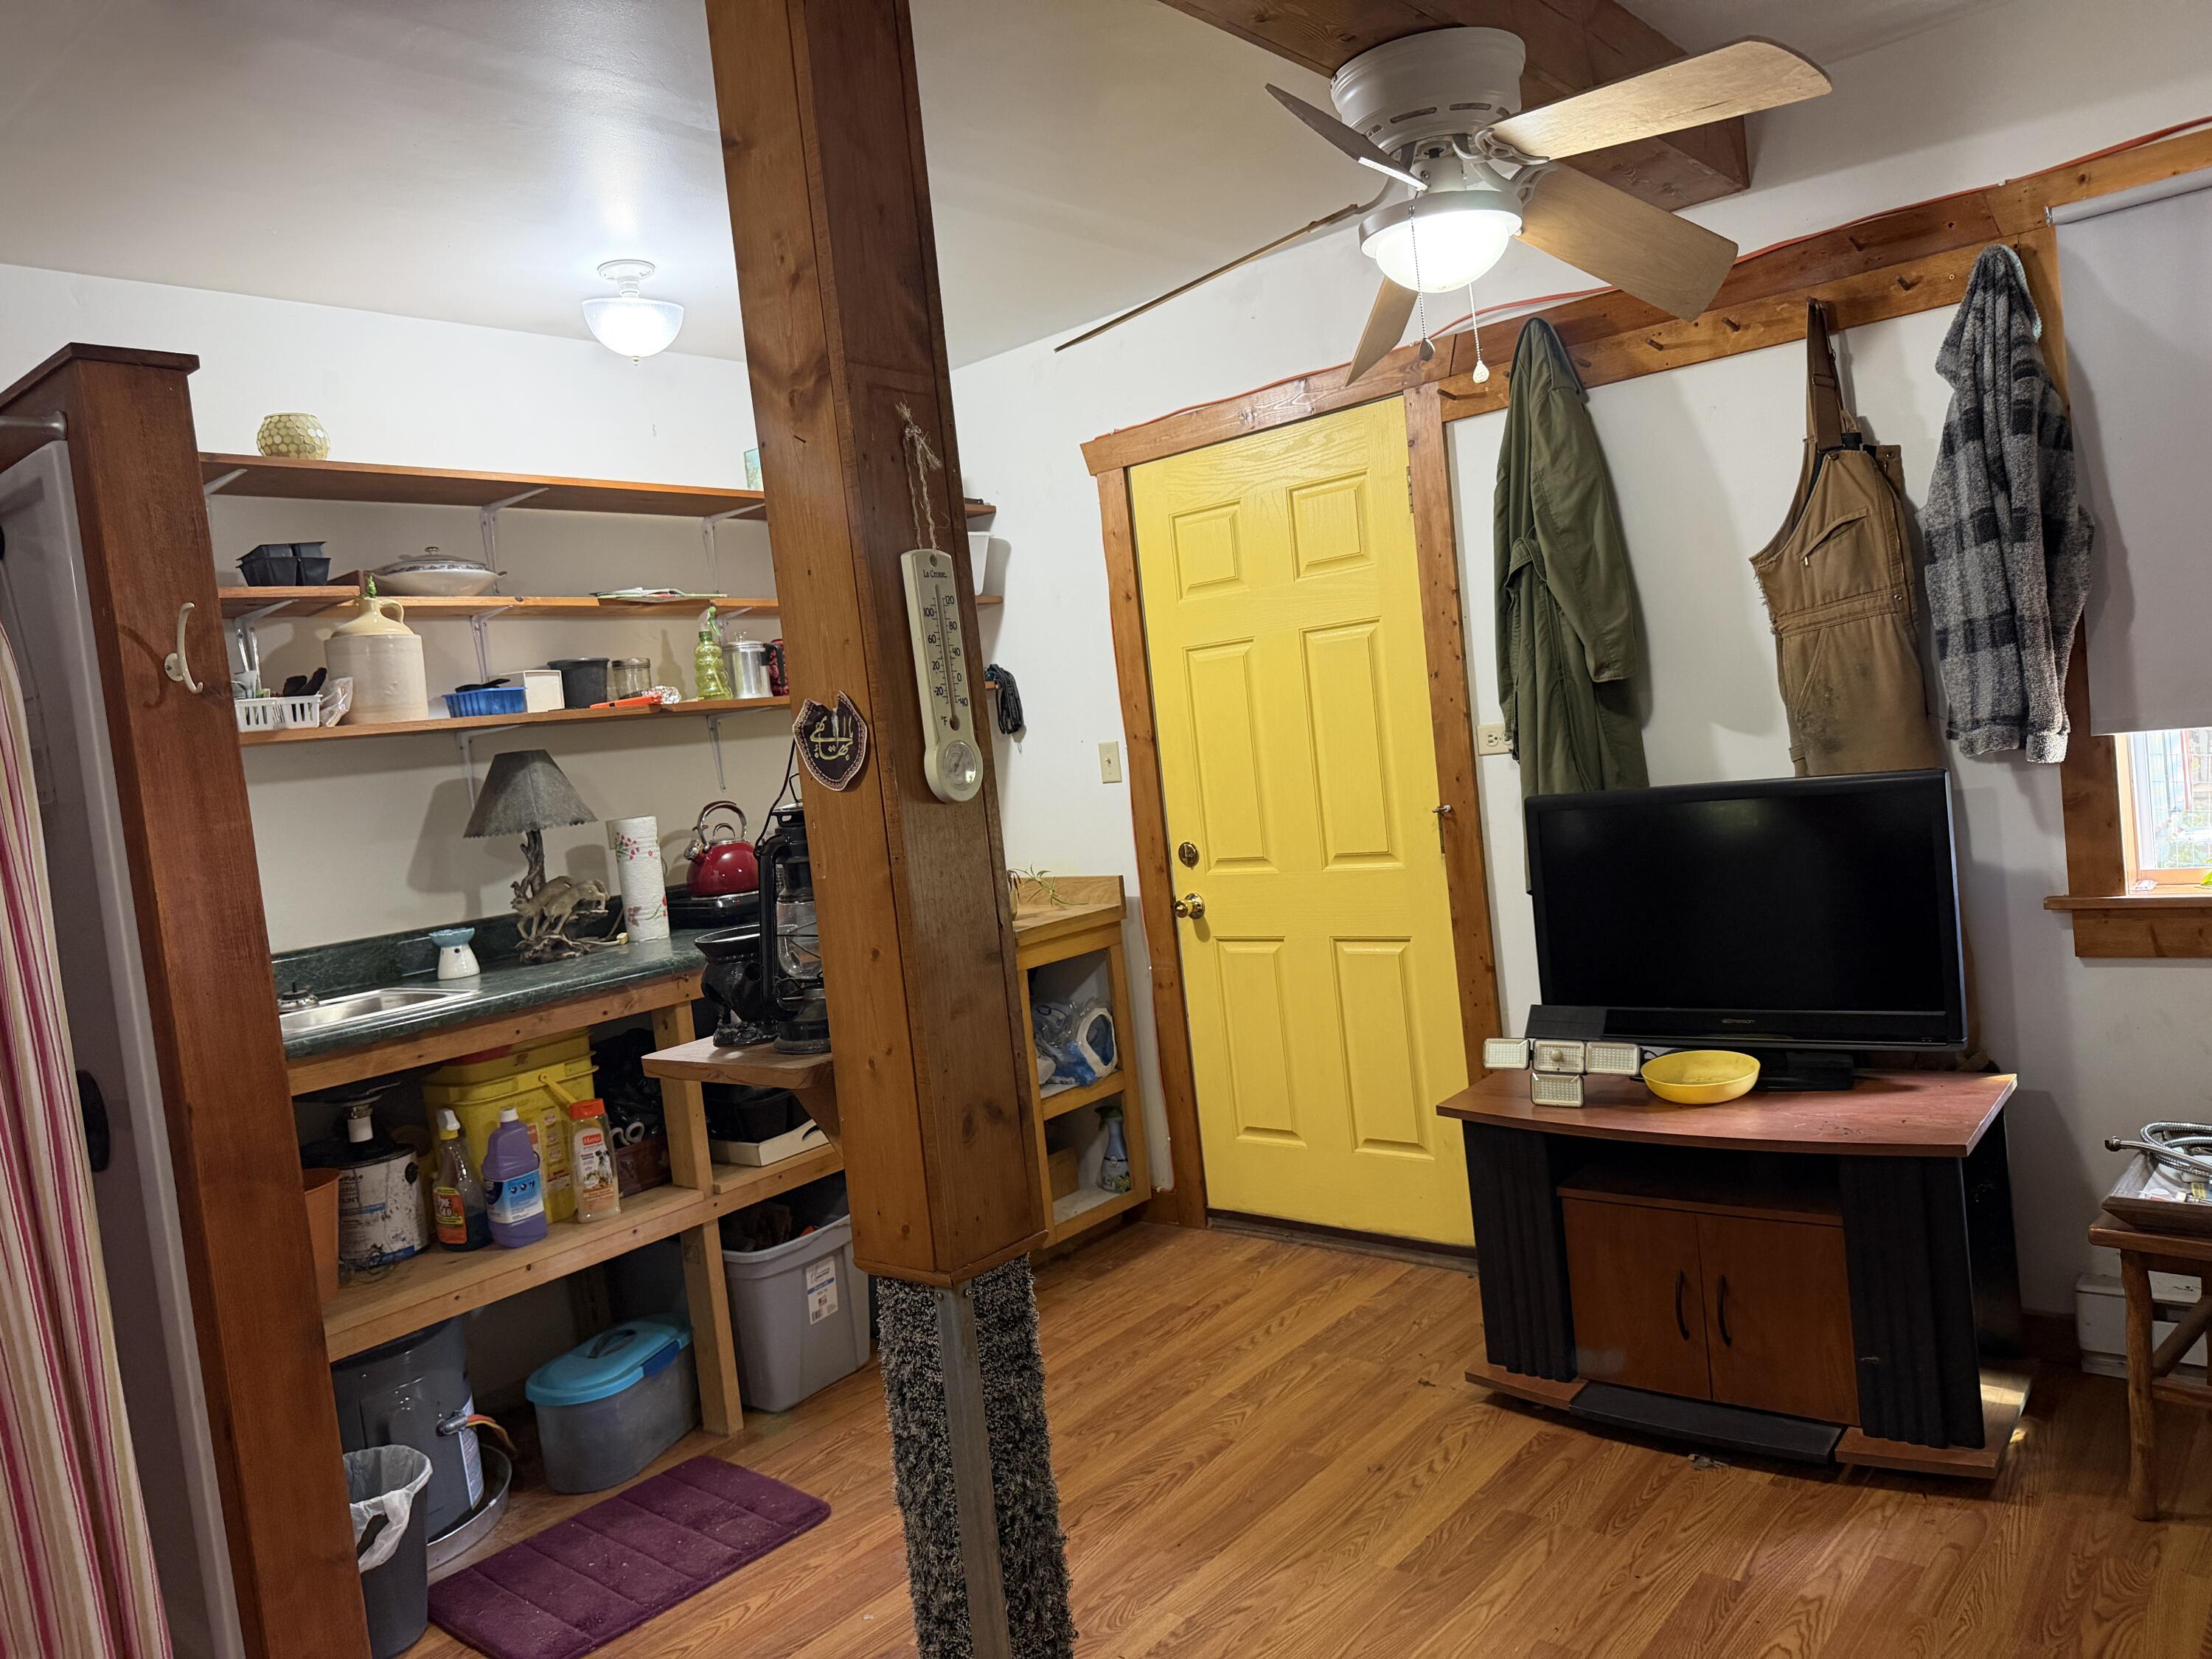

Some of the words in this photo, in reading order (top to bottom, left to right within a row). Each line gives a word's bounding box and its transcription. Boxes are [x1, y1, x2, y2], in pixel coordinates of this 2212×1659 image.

[922, 569, 929, 578] La
[945, 595, 955, 605] 120
[923, 607, 934, 617] 100
[948, 621, 957, 630] 80
[928, 634, 936, 644] 60
[952, 647, 961, 657] 40
[932, 661, 940, 670] 20
[956, 672, 962, 682] 0
[933, 686, 944, 696] -20
[958, 698, 968, 707] -40
